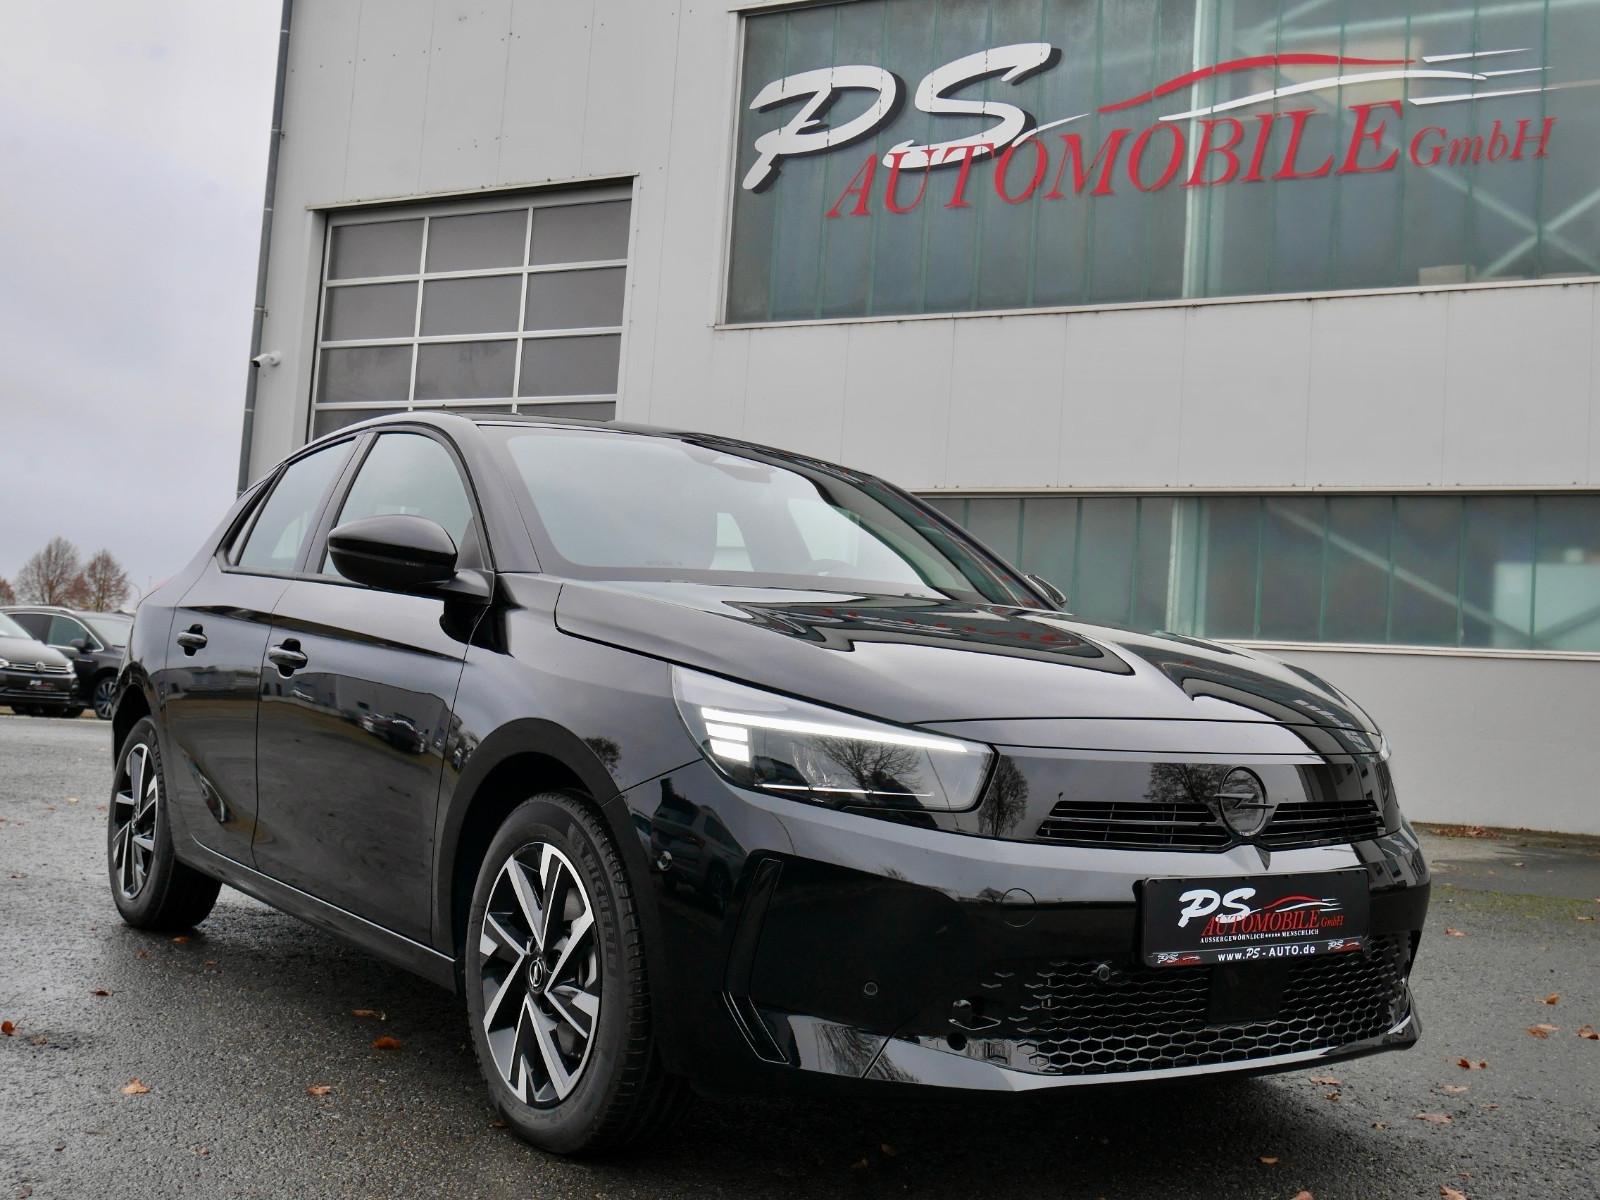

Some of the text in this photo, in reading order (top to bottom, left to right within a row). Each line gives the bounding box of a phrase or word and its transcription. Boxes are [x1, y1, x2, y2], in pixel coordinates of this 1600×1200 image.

[742, 42, 1060, 193] PS
[826, 100, 1556, 219] AUTOMOBILE GmbH
[1177, 887, 1256, 928] PS
[1200, 909, 1345, 937] AUTOMOBILE GmbH
